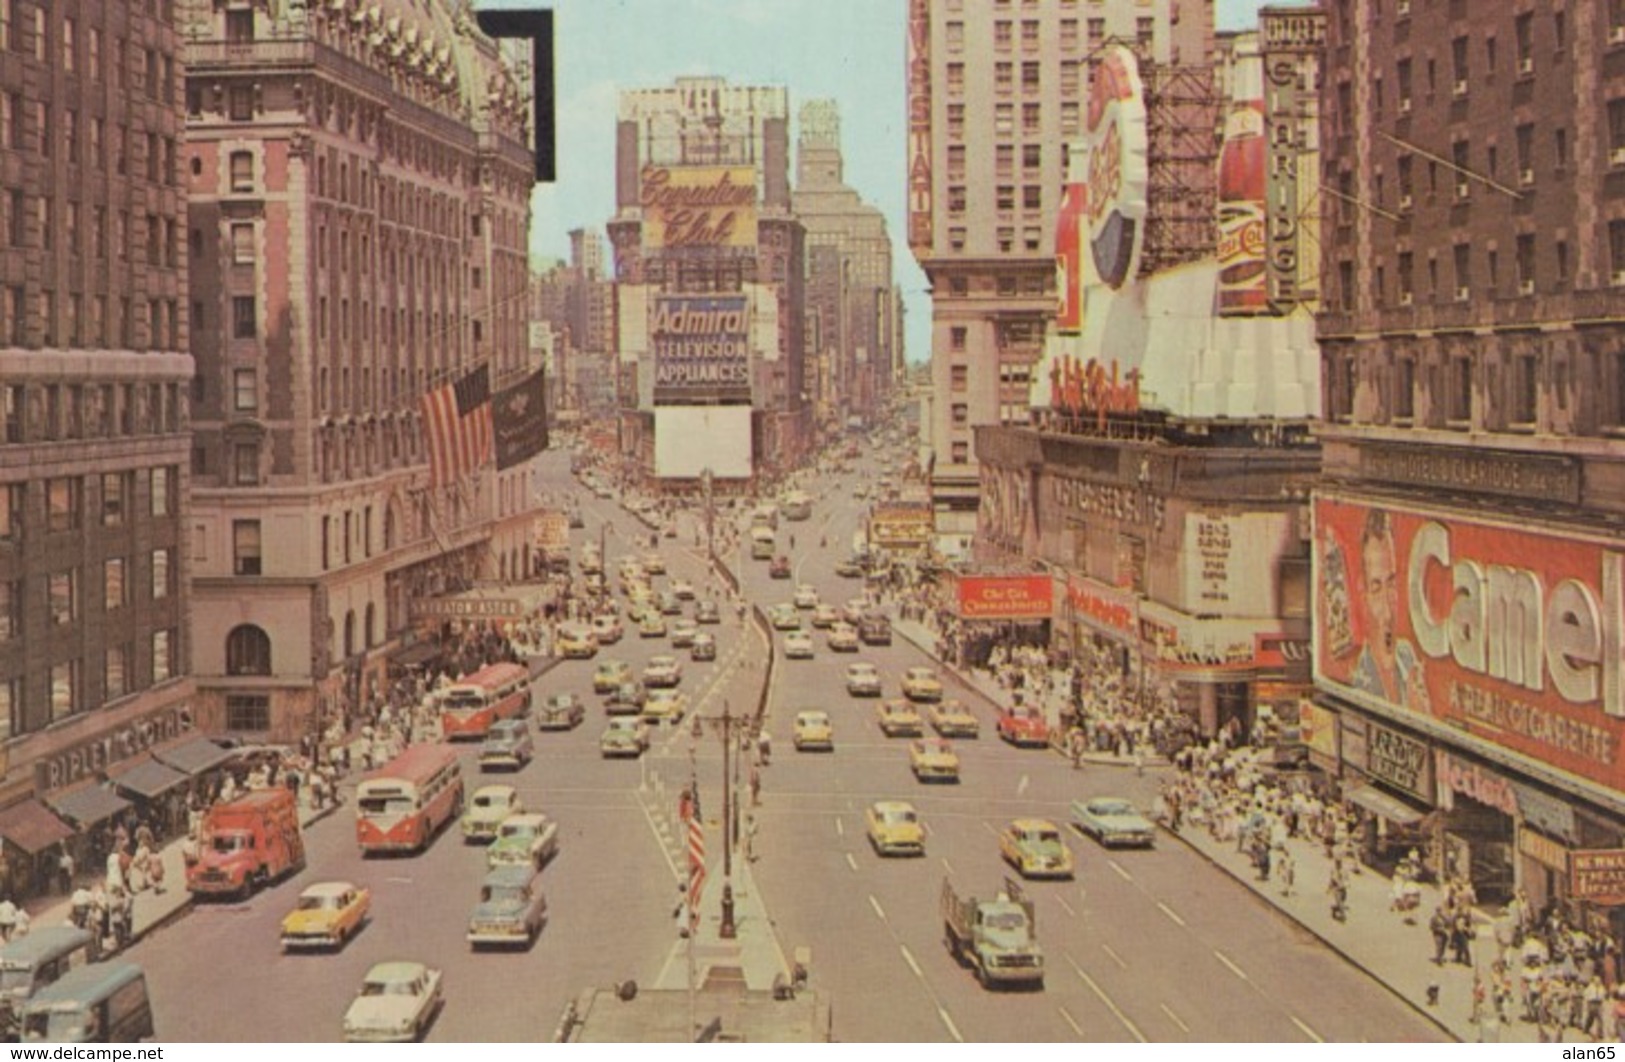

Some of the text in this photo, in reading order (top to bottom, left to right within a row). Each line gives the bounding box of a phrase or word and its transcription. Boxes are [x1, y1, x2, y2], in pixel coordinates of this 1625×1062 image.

[663, 207, 736, 248] Club
[655, 301, 749, 335] Admiral
[658, 340, 747, 361] TELEVISION
[656, 363, 749, 385] APPLIANCES
[1407, 520, 1625, 718] Camel
[1508, 700, 1613, 766] CIGARETTE
